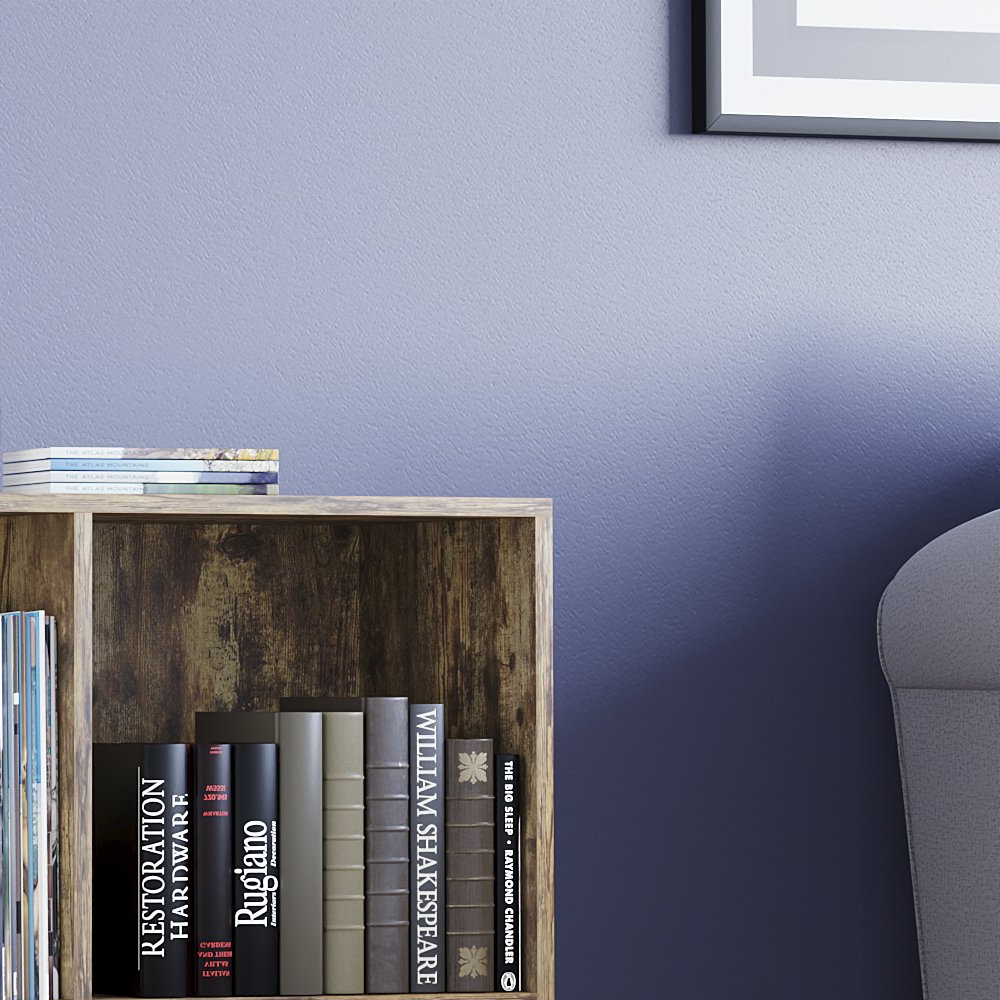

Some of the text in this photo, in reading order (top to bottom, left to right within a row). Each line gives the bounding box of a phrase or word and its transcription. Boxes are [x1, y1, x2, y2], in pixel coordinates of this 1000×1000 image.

[141, 777, 166, 958] RESTORATION
[170, 793, 189, 941] HARDWARE
[233, 820, 279, 928] Rugiano
[415, 708, 438, 985] WILLIAM SHAKESPEARE
[504, 760, 515, 964] THE BIG SLEEP RAYMOND CHANDLER
